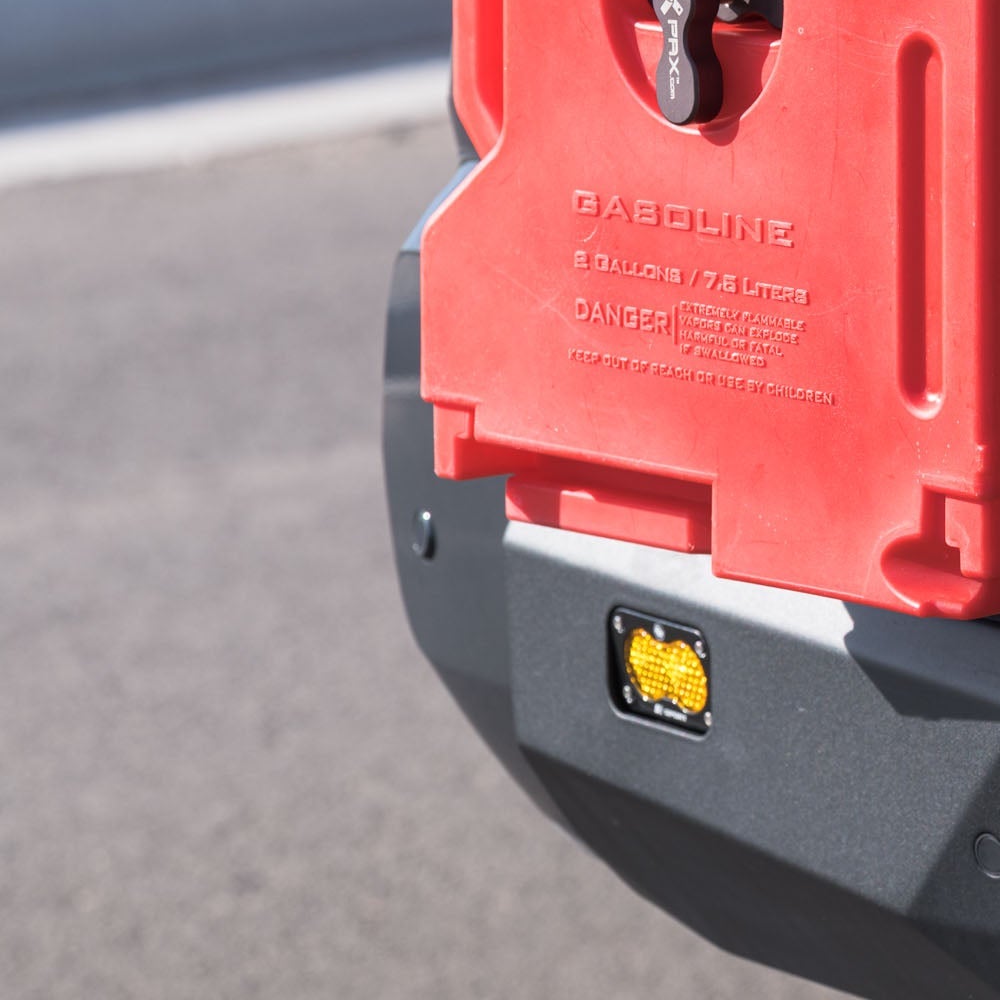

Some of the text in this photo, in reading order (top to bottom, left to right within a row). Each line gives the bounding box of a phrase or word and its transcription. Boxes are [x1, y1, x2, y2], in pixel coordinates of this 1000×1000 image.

[572, 189, 794, 247] GASOLINE
[574, 251, 589, 269] 2
[595, 253, 682, 284] GALLONS
[689, 269, 699, 287] /
[743, 277, 810, 305] LITERS
[575, 297, 670, 336] DANGER
[679, 315, 798, 345] VAPORS CAN EXPLODE
[680, 301, 805, 332] EXTREMELY FLAMMABLE
[680, 330, 728, 347] HARMFUL
[732, 339, 745, 350] OR
[680, 344, 766, 368] IF SWALLOWED
[568, 348, 834, 406] KEEP OUT OF REACH OR USE BY CHILDREN
